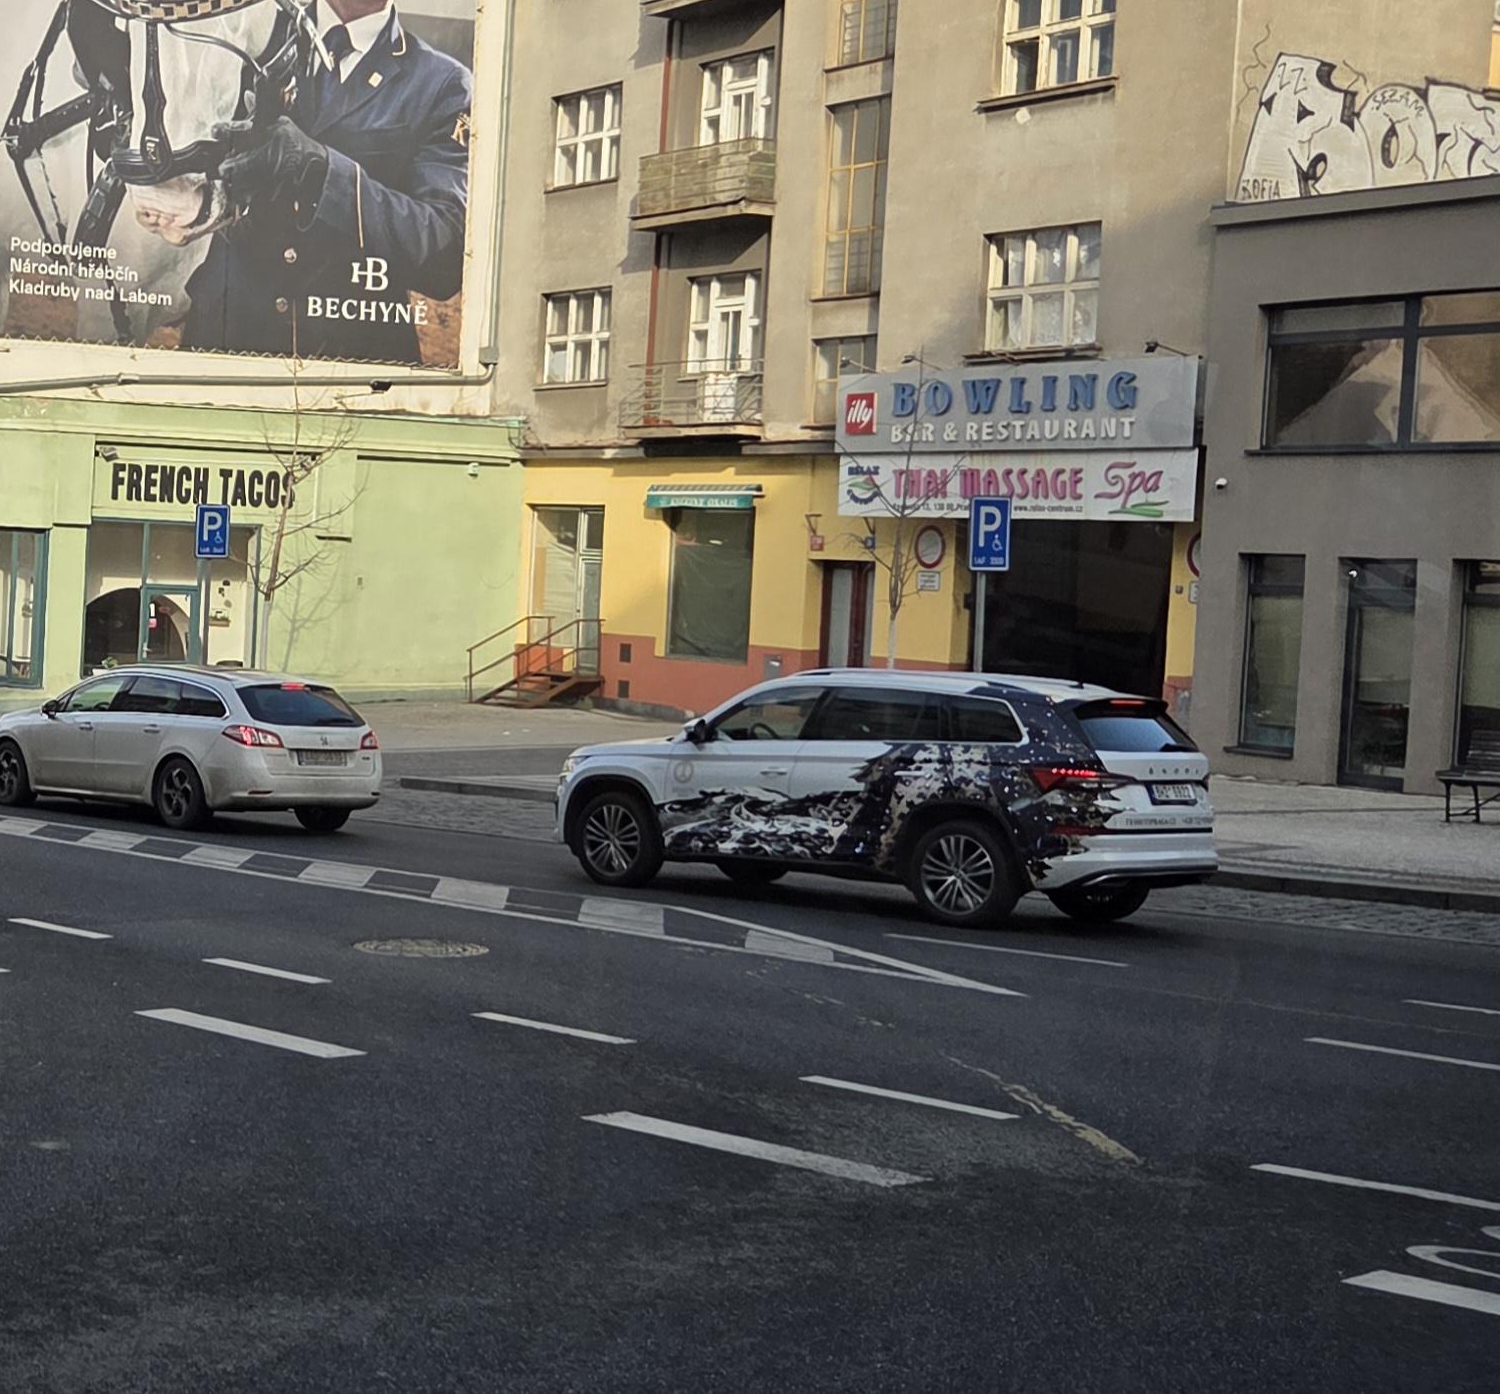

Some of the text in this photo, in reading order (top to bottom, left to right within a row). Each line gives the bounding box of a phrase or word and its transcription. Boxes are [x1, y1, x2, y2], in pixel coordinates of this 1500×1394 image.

[10, 237, 117, 260] Podporujeme
[9, 257, 138, 282] Národní hřebčín
[9, 279, 173, 306] Kladruby nad Labem
[307, 295, 428, 326] BECHYNĚ
[891, 370, 1138, 418] BOWLING
[847, 399, 873, 429] illy
[890, 416, 1137, 444] BAR & RESTAURANT
[110, 462, 296, 509] FRENCH TACOS
[959, 467, 1085, 500] MASSAGE
[1093, 461, 1165, 509] Spa
[978, 505, 1001, 548] P
